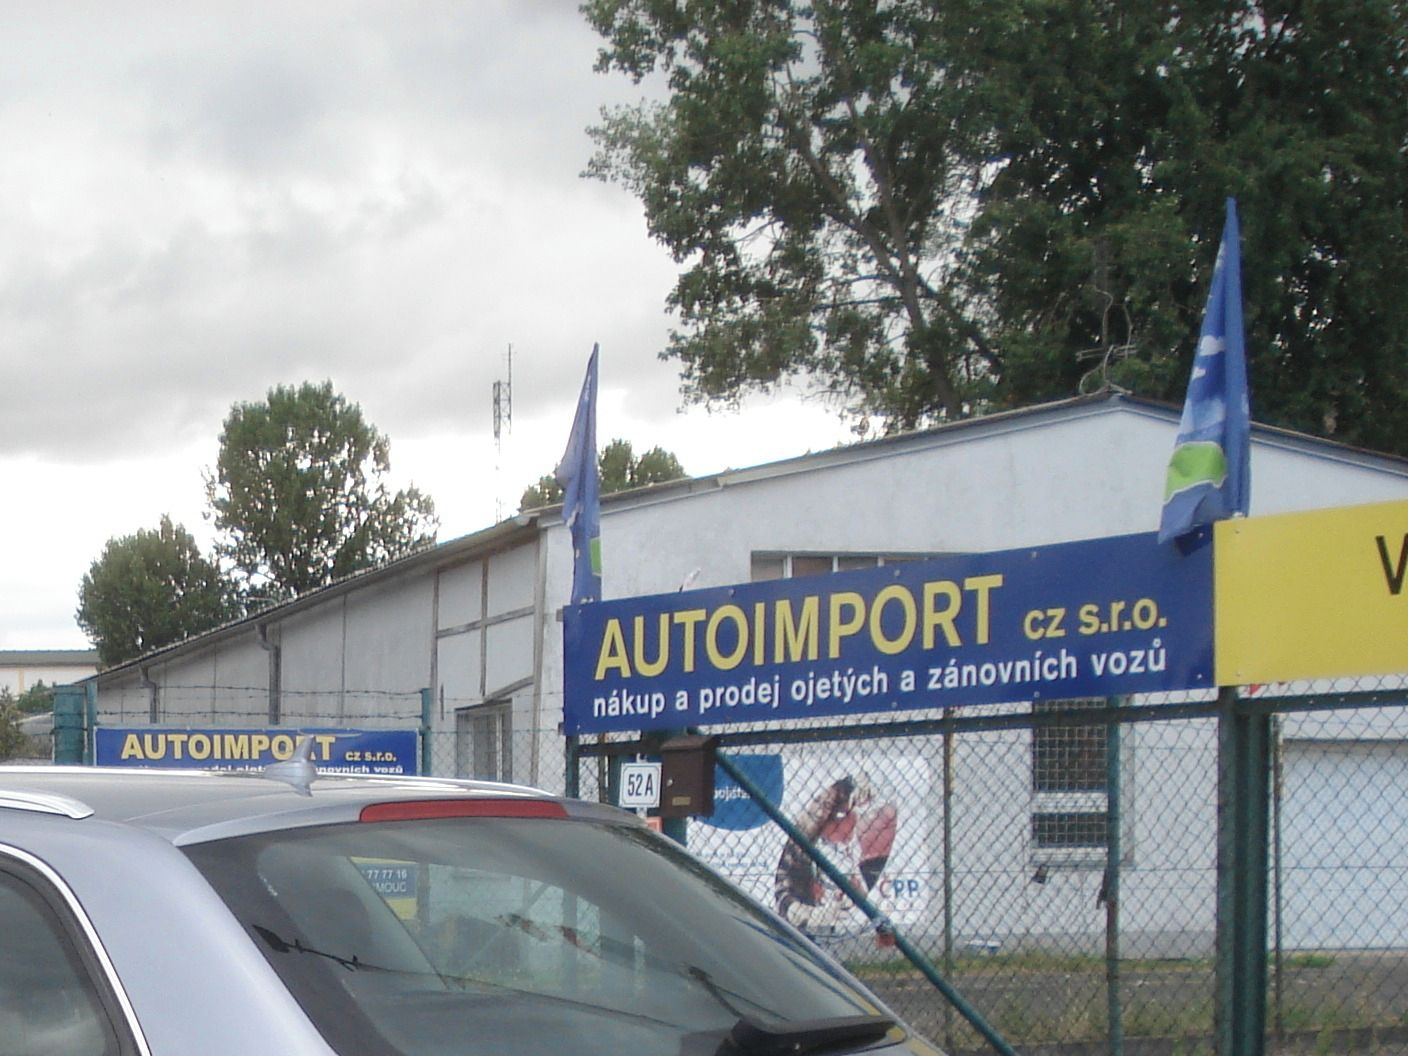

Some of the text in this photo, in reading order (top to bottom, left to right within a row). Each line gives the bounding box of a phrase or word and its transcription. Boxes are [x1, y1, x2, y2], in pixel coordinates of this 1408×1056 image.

[594, 573, 1004, 681] AUTOIMPORT
[1078, 598, 1168, 636] s.r.o.
[593, 637, 1167, 719] nákup a prodej ojetých a zánovních vozů
[364, 750, 398, 762] s.r.o.
